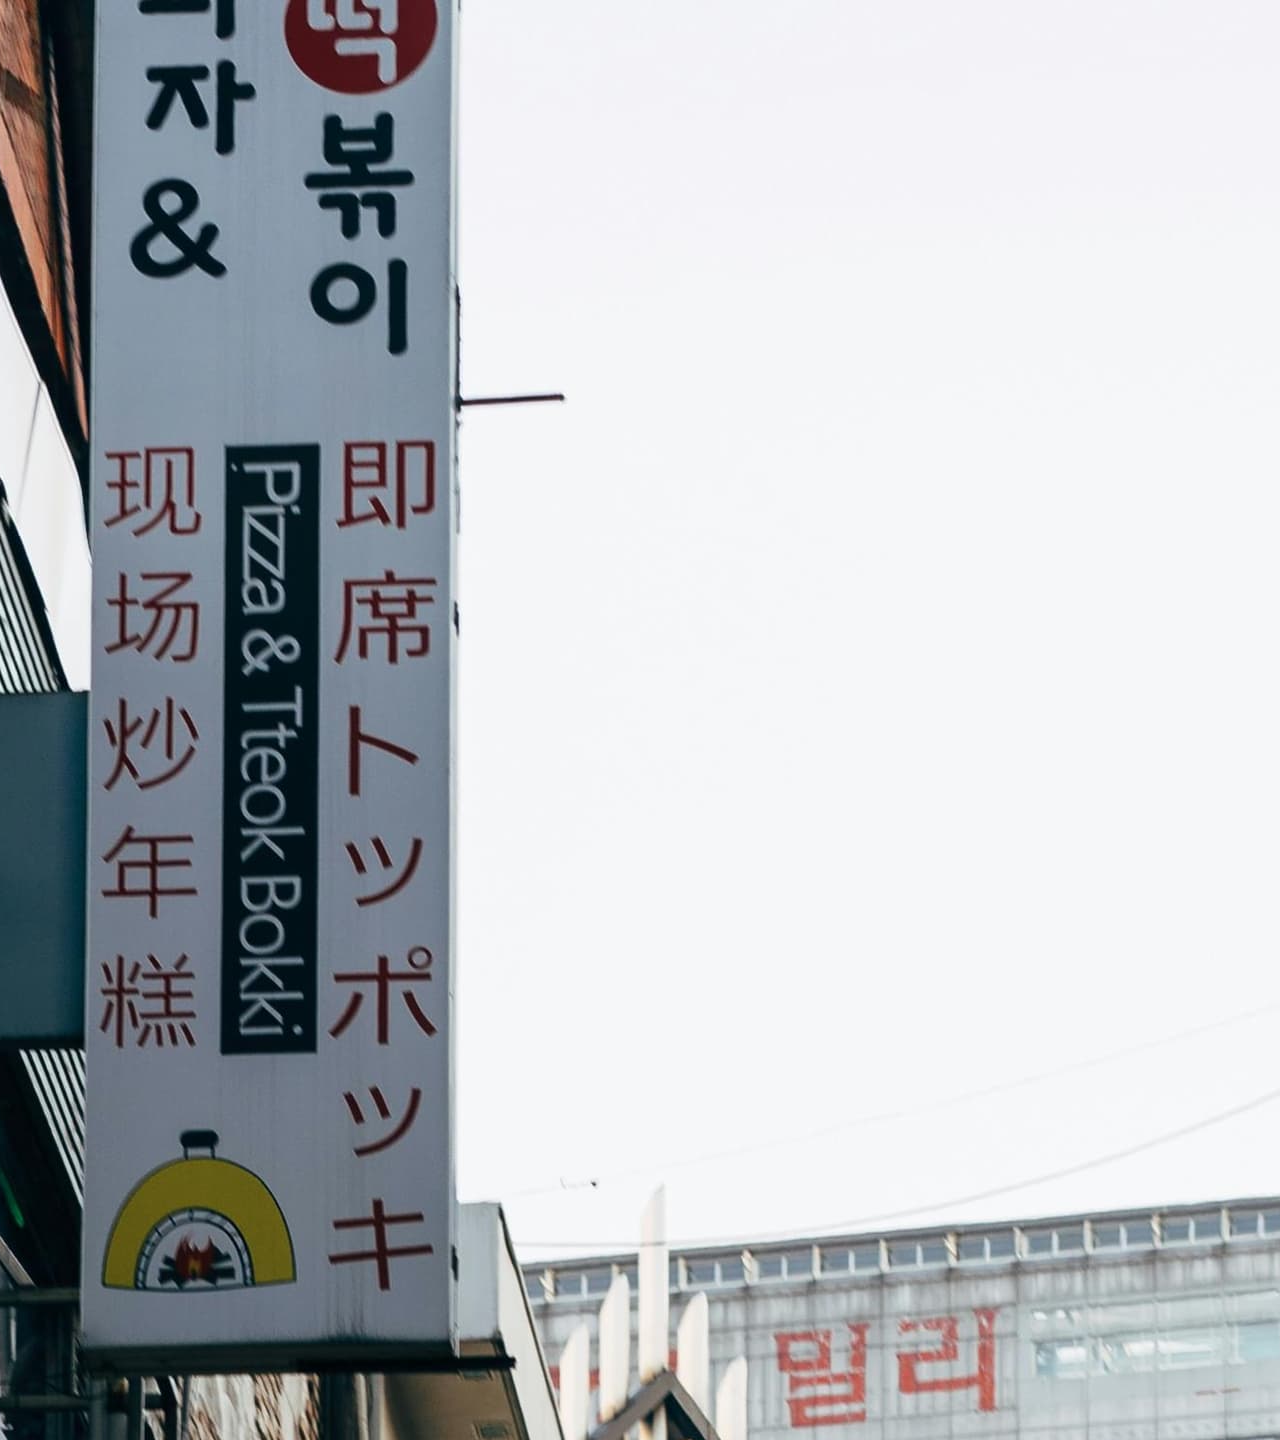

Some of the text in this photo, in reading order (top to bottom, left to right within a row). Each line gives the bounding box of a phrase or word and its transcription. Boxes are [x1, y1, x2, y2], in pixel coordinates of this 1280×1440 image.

[100, 446, 201, 1050] 现场炒年糕
[234, 461, 304, 1038] Pizza & Tteok Bokki
[330, 440, 438, 1293] 即席トッポッキ
